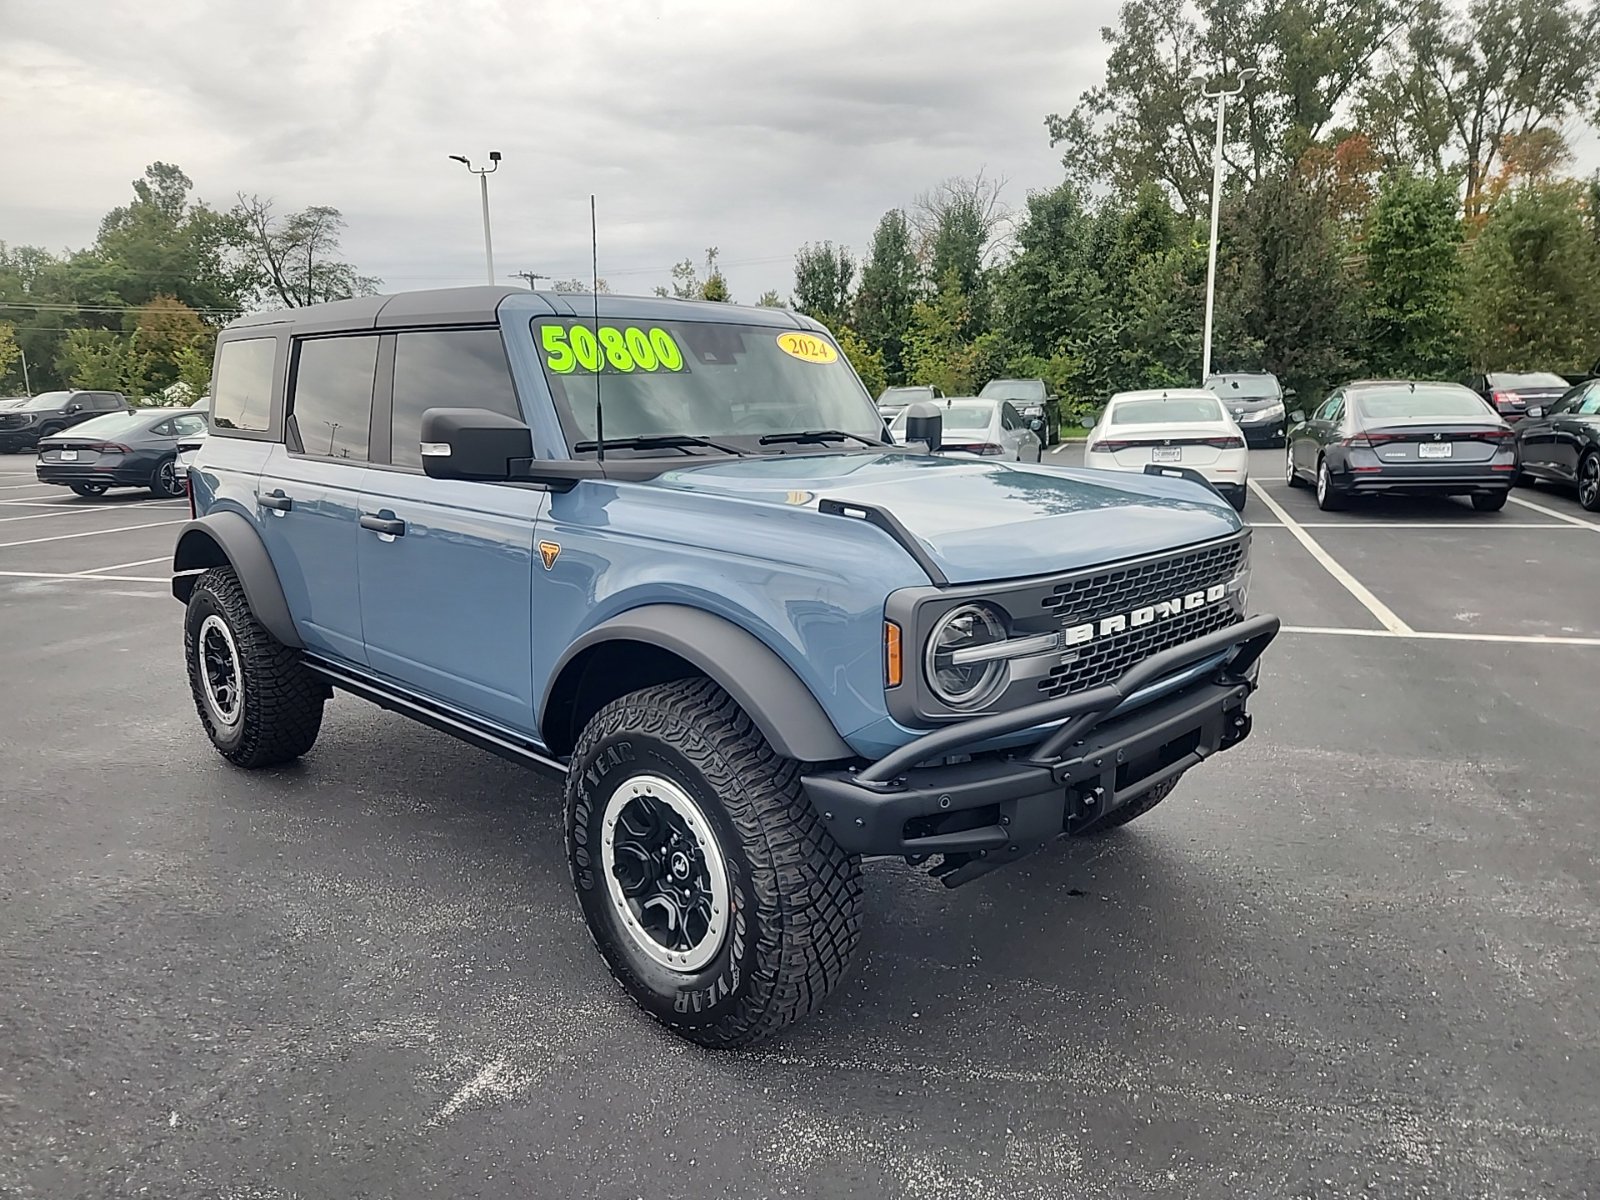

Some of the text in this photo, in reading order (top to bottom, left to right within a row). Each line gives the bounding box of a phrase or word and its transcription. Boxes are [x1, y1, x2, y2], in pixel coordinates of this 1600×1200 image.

[541, 325, 683, 374] 50800
[788, 338, 828, 358] 2024
[1065, 584, 1225, 646] BRONCO
